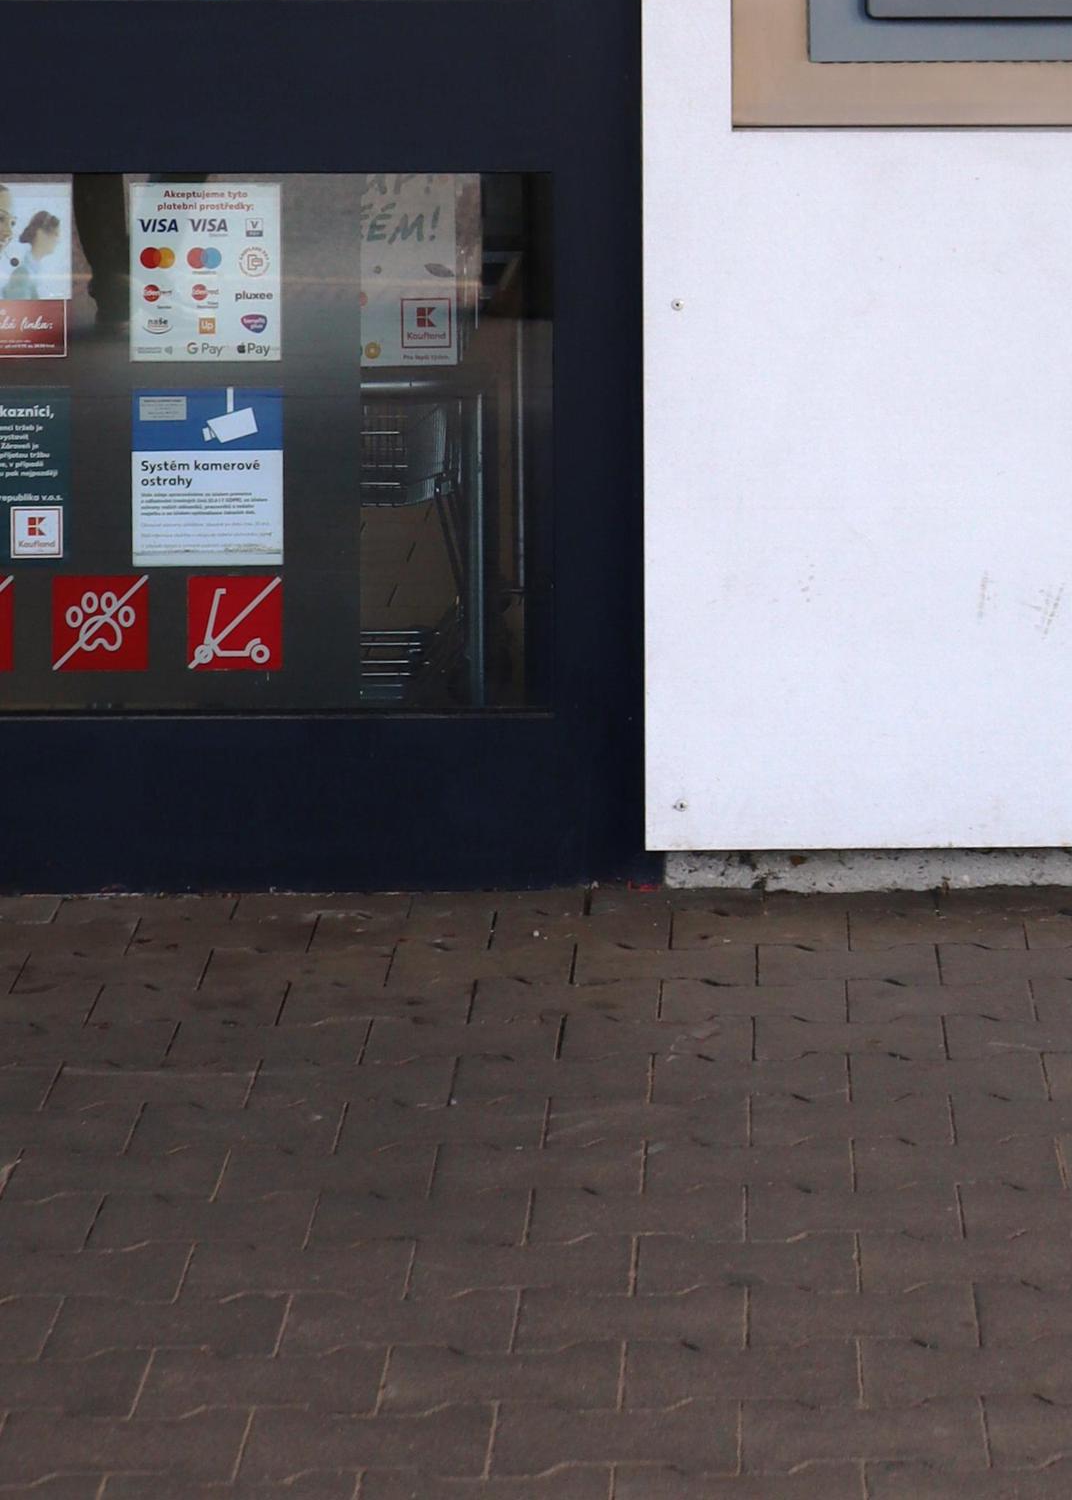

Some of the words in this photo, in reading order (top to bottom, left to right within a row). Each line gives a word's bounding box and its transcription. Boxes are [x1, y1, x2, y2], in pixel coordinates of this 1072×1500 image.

[163, 190, 225, 200] Akceptujeme
[227, 190, 248, 200] tyto
[139, 219, 179, 233] VISA
[188, 219, 228, 232] VISA
[235, 291, 273, 302] pluxee
[201, 343, 223, 357] Pay
[247, 343, 270, 357] Pay
[141, 460, 190, 474] Systém
[194, 459, 260, 471] kamerové
[141, 475, 193, 488] ostrahy
[18, 540, 56, 548] Kaufland
